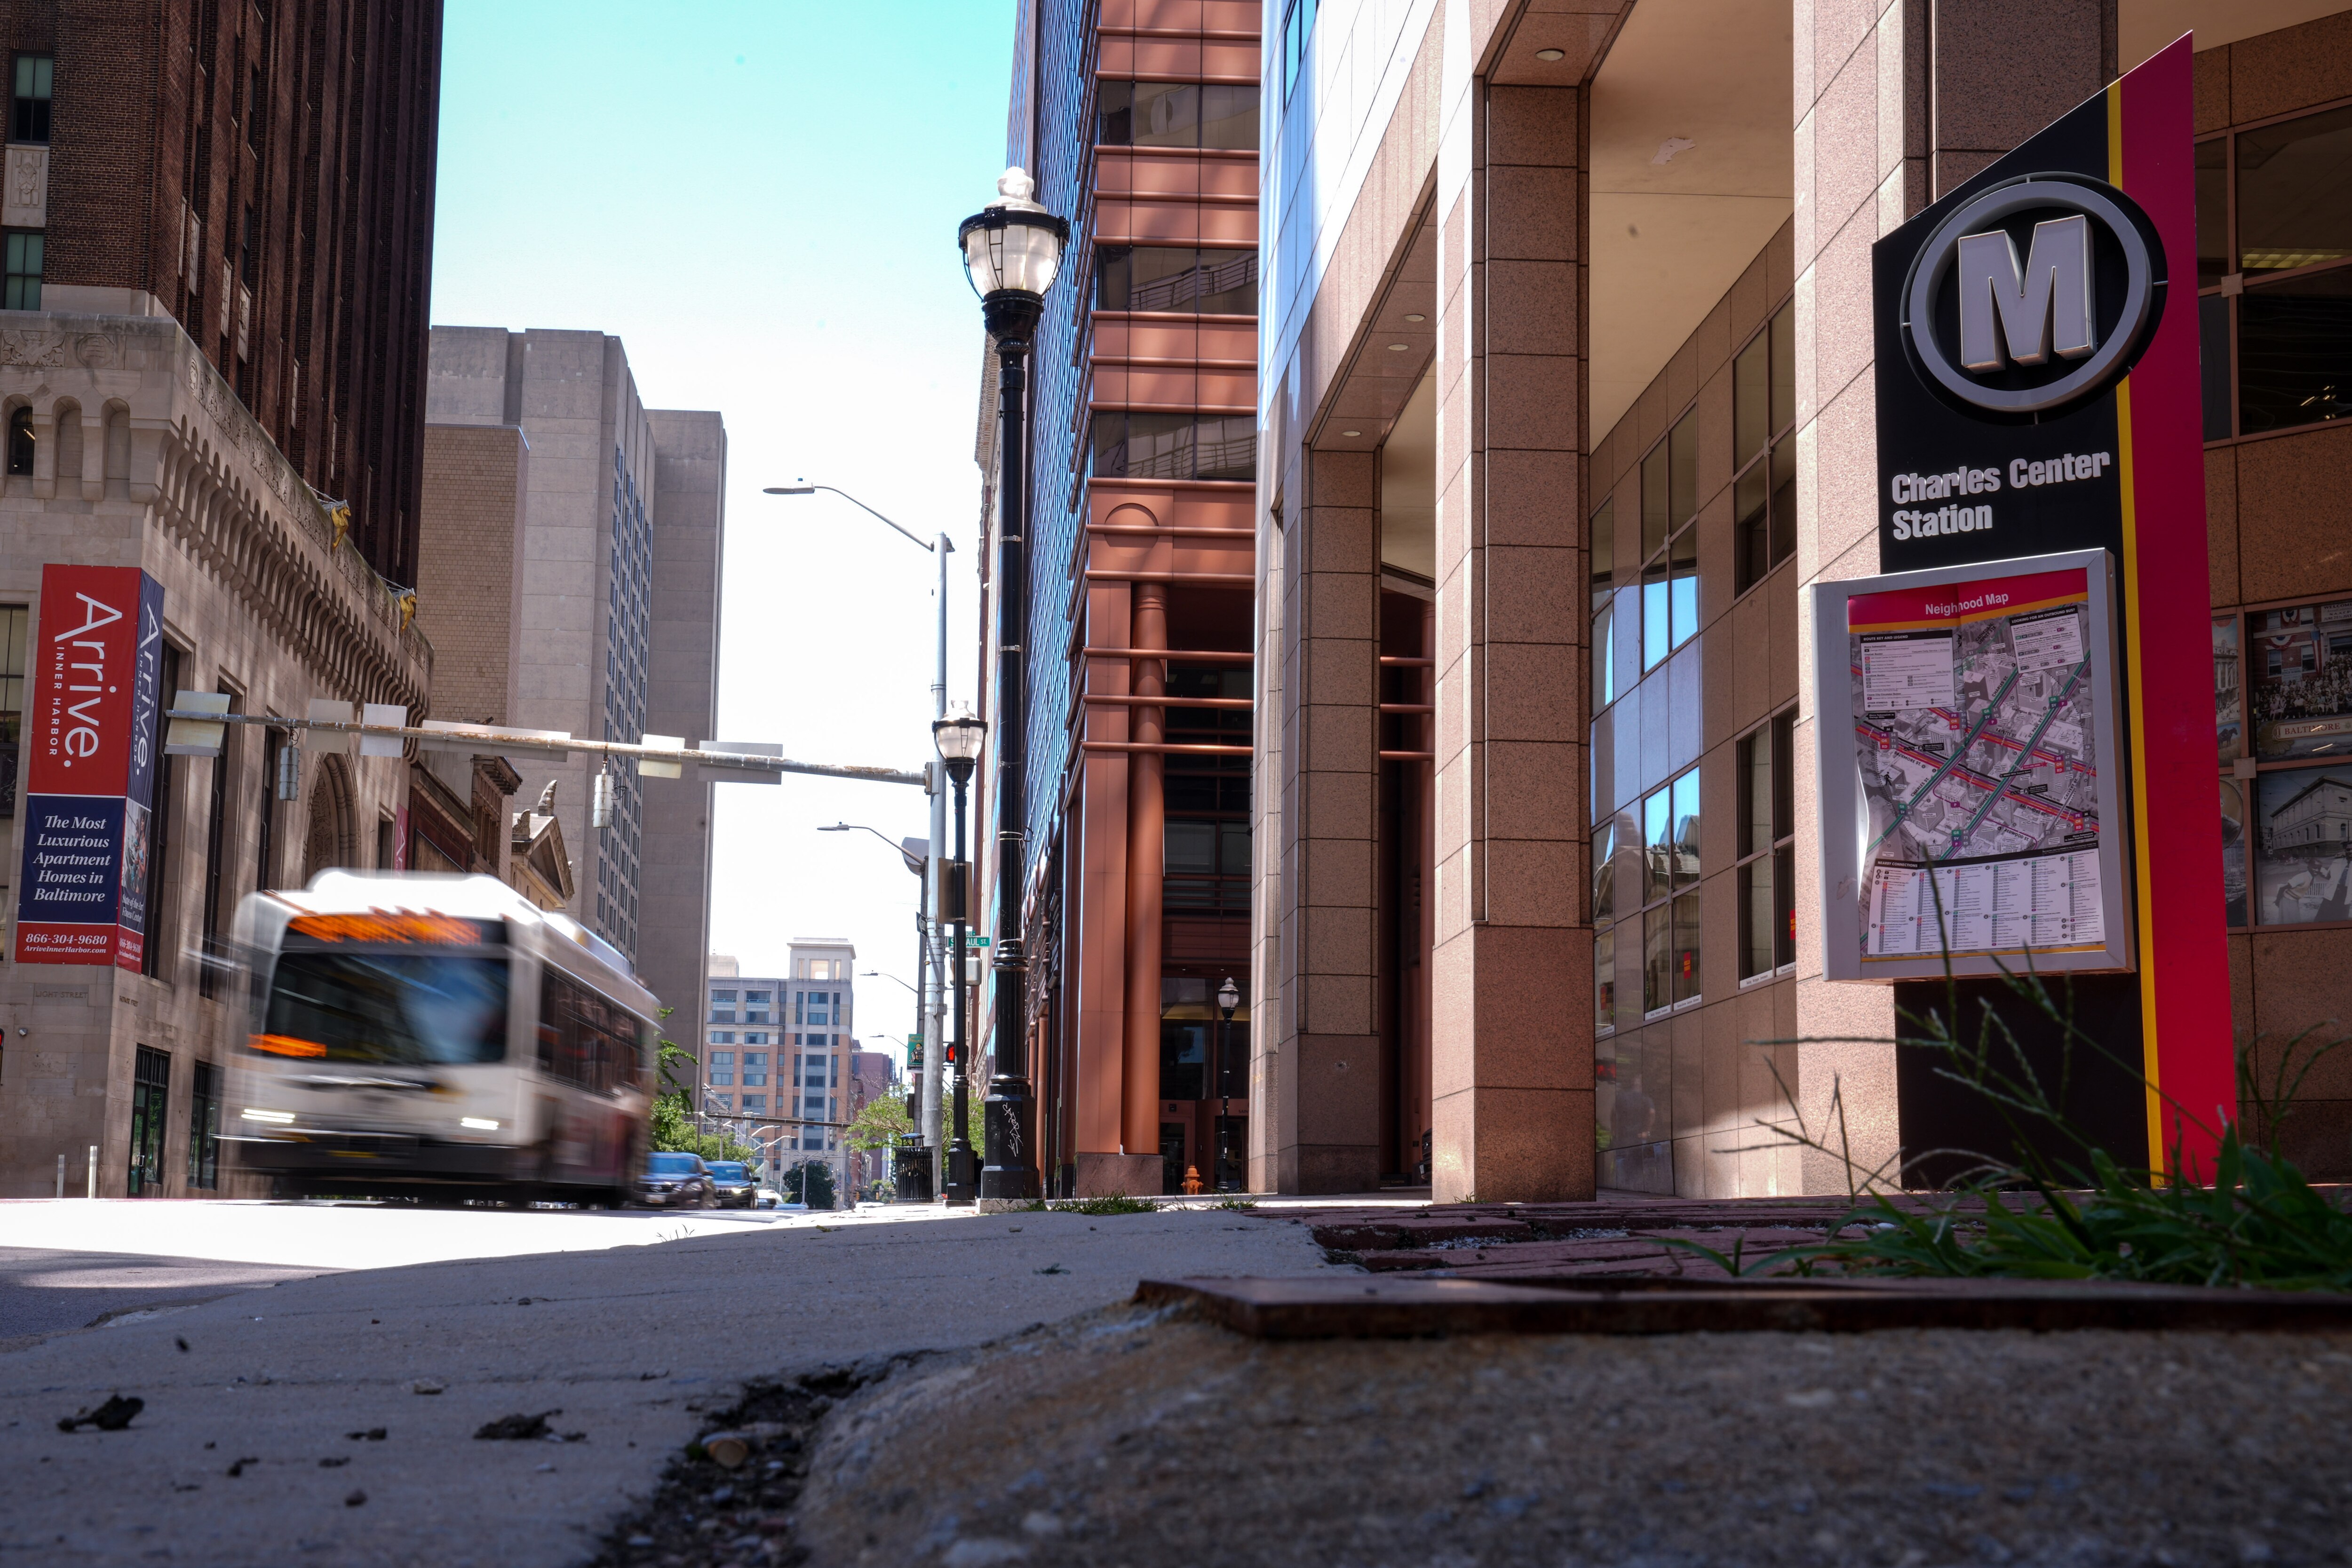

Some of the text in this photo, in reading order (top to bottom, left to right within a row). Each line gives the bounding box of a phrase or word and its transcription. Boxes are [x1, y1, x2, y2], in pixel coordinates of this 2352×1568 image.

[1958, 215, 2097, 374] M
[1892, 451, 2111, 504] Charles Center
[1893, 503, 1993, 540] Station
[1985, 593, 2009, 605] Map
[49, 647, 64, 755] INNER HARBOR
[2285, 723, 2340, 735] BALTIMORE
[1911, 781, 1925, 796] CHARLES
[45, 815, 106, 829] The Most
[37, 834, 109, 847] Luxurious
[33, 852, 111, 868] Apartment
[38, 870, 103, 883] Homes in
[34, 888, 105, 902] Baltimore
[26, 934, 107, 945] 866-304-9680
